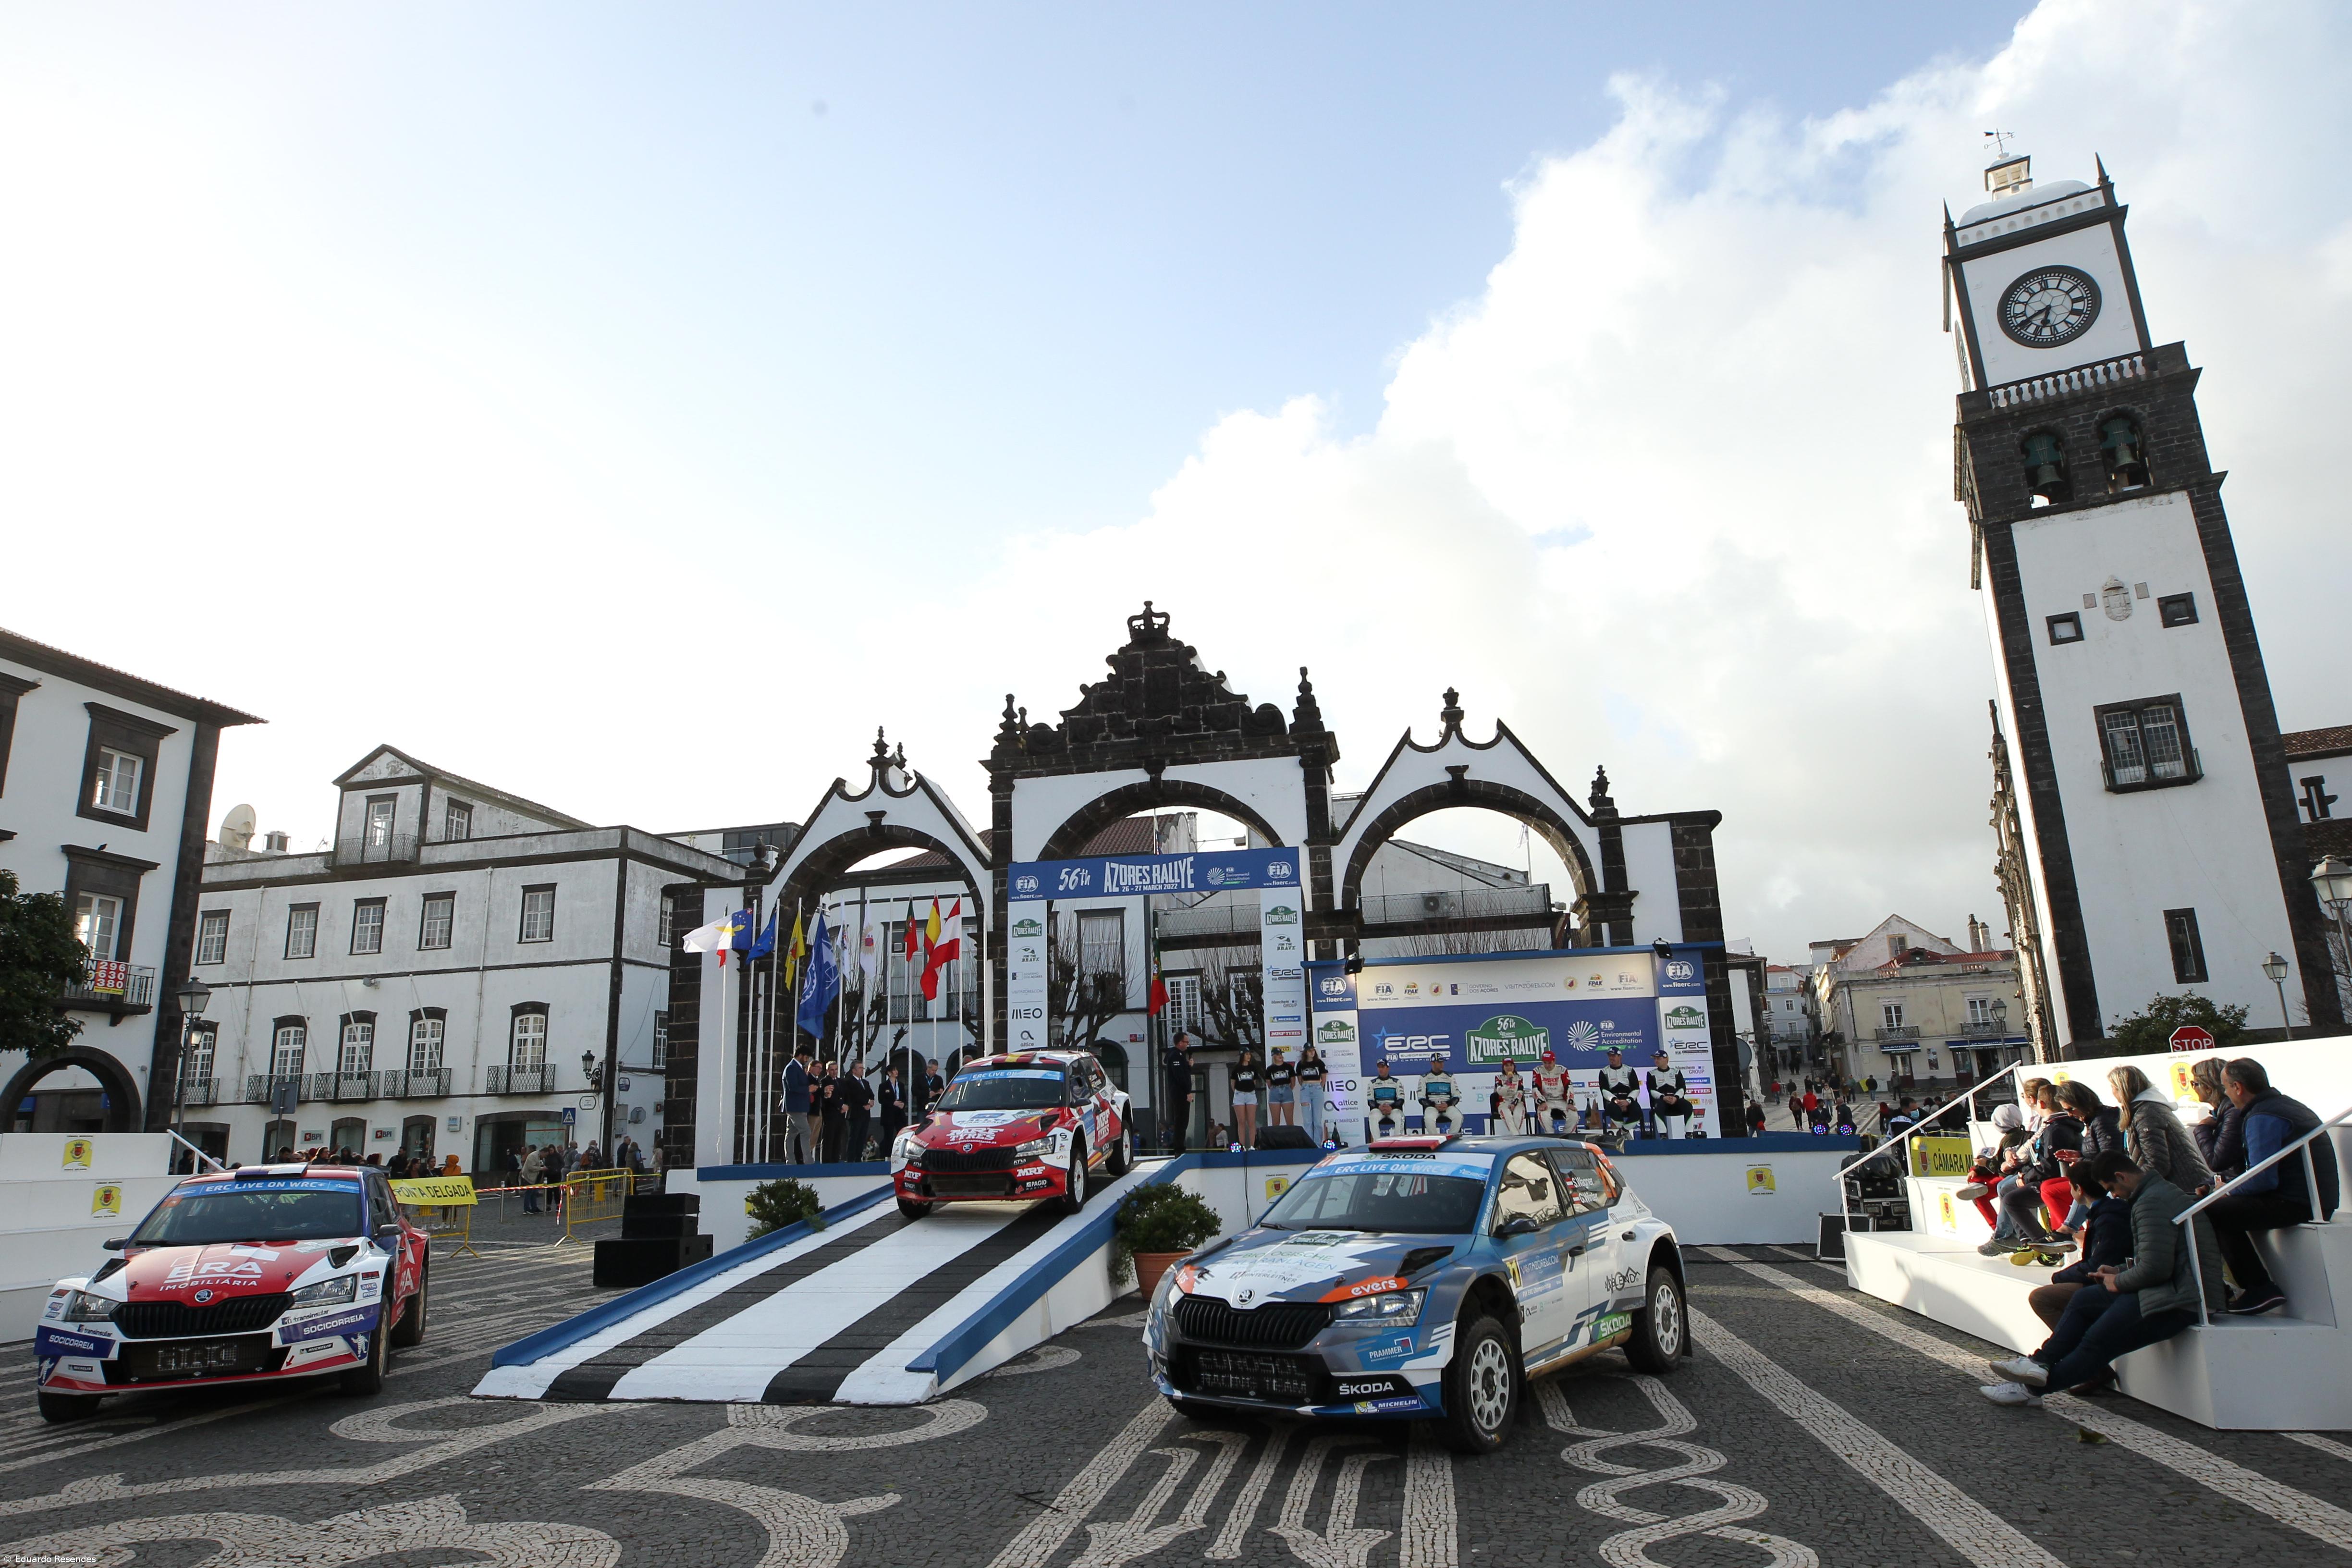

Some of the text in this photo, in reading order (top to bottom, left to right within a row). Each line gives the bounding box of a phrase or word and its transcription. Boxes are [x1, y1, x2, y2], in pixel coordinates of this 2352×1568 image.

[1058, 868, 1091, 891] 56th
[1104, 856, 1194, 893] AZORES RALLYE
[1267, 912, 1297, 924] AZORES RALLYE
[1013, 925, 1041, 937] AZORES RALLYE
[99, 961, 126, 972] 296
[1272, 968, 1301, 977] ERC
[98, 969, 124, 980] 630
[97, 978, 123, 989] 380
[1012, 1008, 1042, 1019] MEO
[1497, 1017, 1516, 1031] 56th
[1666, 1014, 1704, 1028] AZORES RALLYE
[1319, 1028, 1354, 1042] AZORES RALLYE
[1384, 1035, 1450, 1051] ERC
[1470, 1032, 1546, 1062] AZORES RALLYE
[1675, 1041, 1708, 1050] ERC
[2172, 1038, 2212, 1052] STOP
[1323, 1079, 1357, 1092] MEO
[946, 1127, 1004, 1137] MRF
[950, 1133, 996, 1141] TYRES
[1933, 1149, 1963, 1172] CÂMARA
[904, 1170, 921, 1180] MRF
[1017, 1166, 1046, 1177] MRF
[1335, 1164, 1359, 1174] ERC
[1360, 1164, 1389, 1172] LIVE
[1571, 1176, 1594, 1189] S.Wagner
[426, 1185, 471, 1199] DELGADA
[1579, 1191, 1598, 1204] G.Winter
[1243, 1251, 1334, 1262] BIOOGISCHE
[167, 1261, 263, 1279] ERA
[159, 1277, 258, 1292] IMOBILIÁRIA
[1351, 1278, 1397, 1296] evers
[293, 1310, 330, 1323] transinsular
[303, 1314, 365, 1335] SOCICORREIA
[1600, 1313, 1632, 1337] ŠKODA
[84, 1327, 113, 1337] transinsular
[49, 1335, 94, 1350] SOCICORREIA
[307, 1344, 332, 1353] MICHELIN
[1369, 1346, 1402, 1359] PRAMMER
[1339, 1381, 1395, 1395] ŠKODA
[1378, 1399, 1418, 1408] MICHELIN
